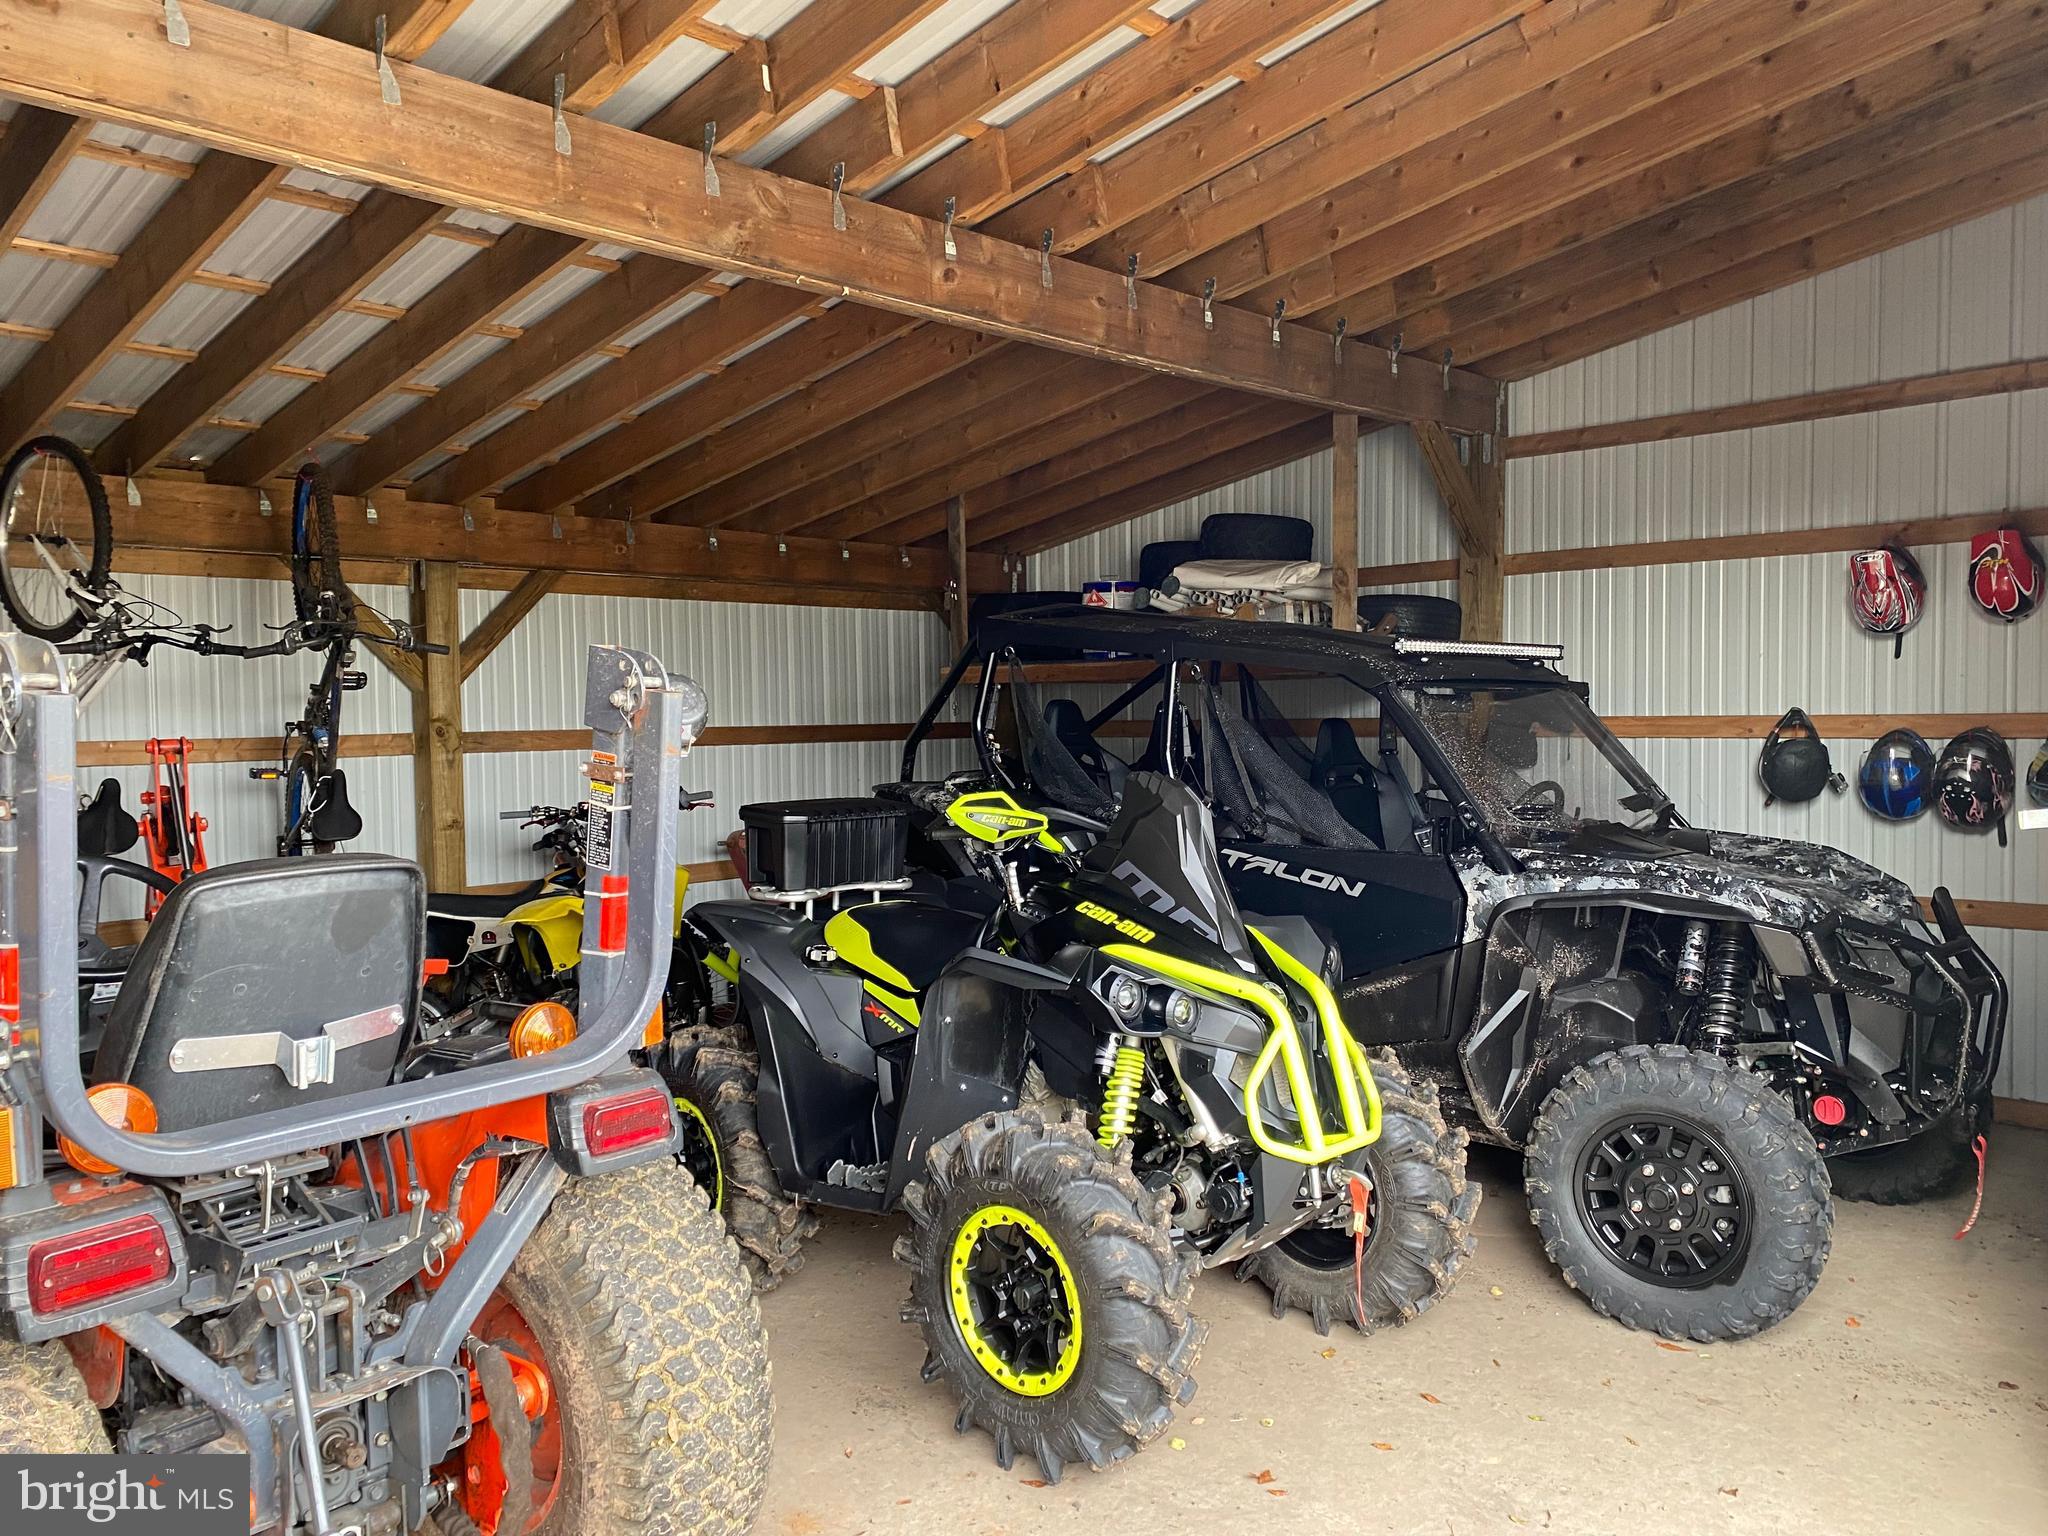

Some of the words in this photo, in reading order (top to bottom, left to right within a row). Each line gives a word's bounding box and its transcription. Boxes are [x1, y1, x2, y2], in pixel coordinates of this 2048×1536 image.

[980, 814, 1026, 828] can-am
[1220, 848, 1367, 898] TALON
[1074, 900, 1156, 944] can-am
[983, 1180, 1008, 1190] ITP
